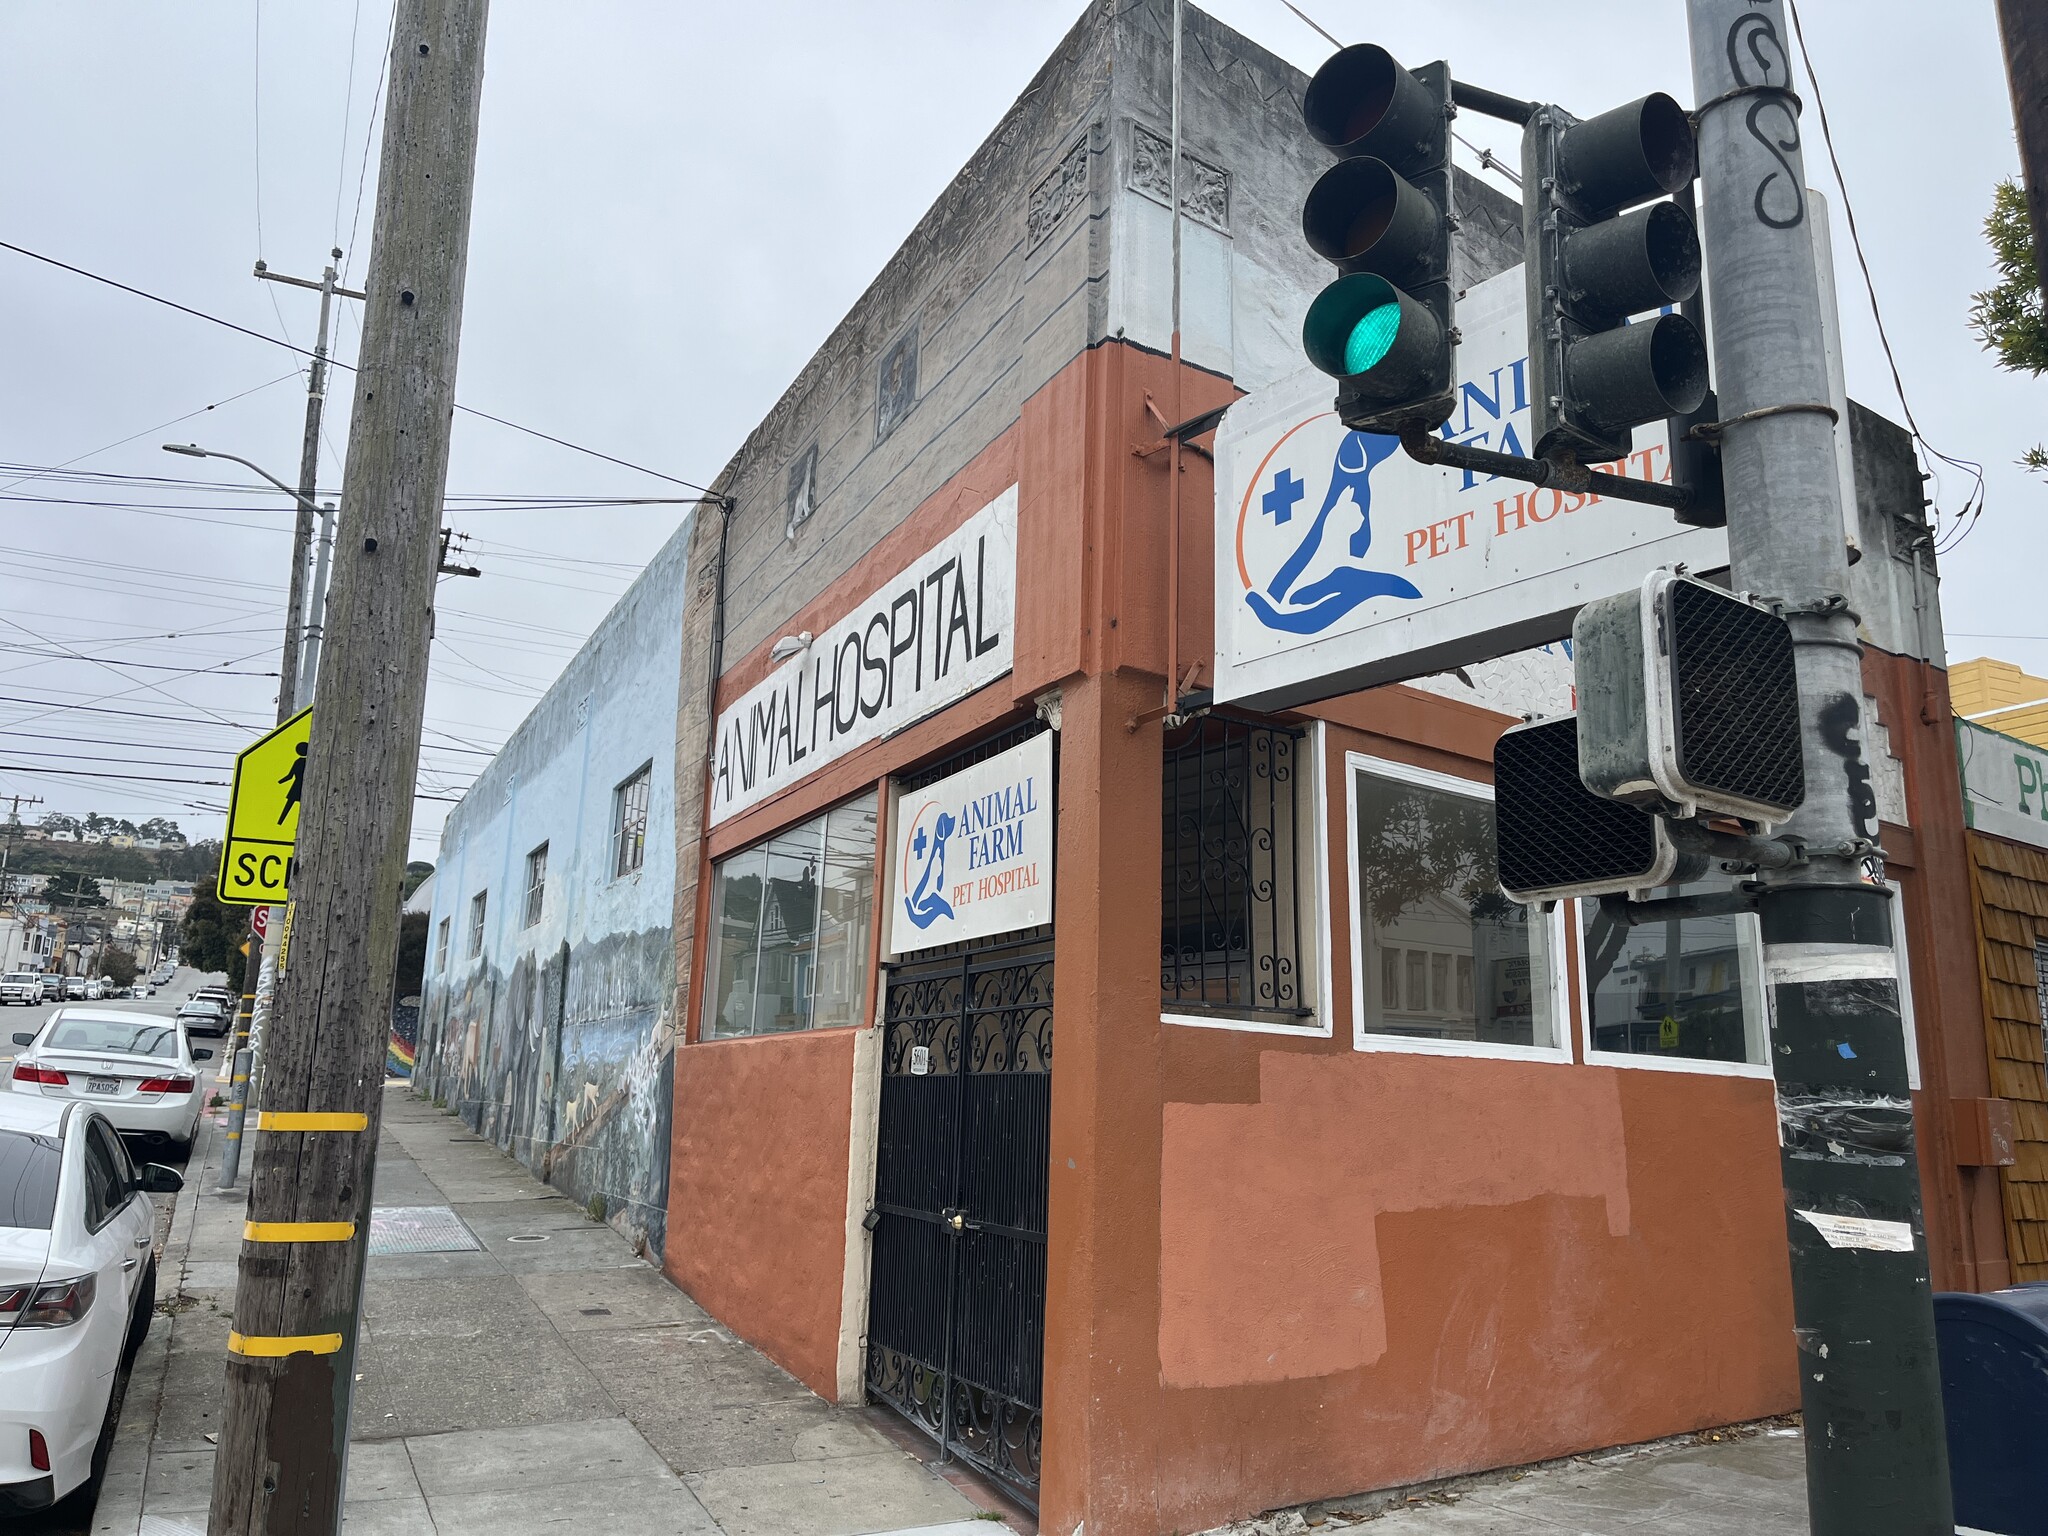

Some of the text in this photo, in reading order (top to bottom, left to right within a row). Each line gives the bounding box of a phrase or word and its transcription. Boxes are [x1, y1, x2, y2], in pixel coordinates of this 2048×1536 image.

[1404, 510, 1474, 567] PET
[713, 535, 999, 810] ANIMAL HOSPITAL
[957, 776, 1038, 838] ANIMAL
[968, 819, 1024, 871] FARM
[952, 862, 1040, 908] PET HOSPITAL
